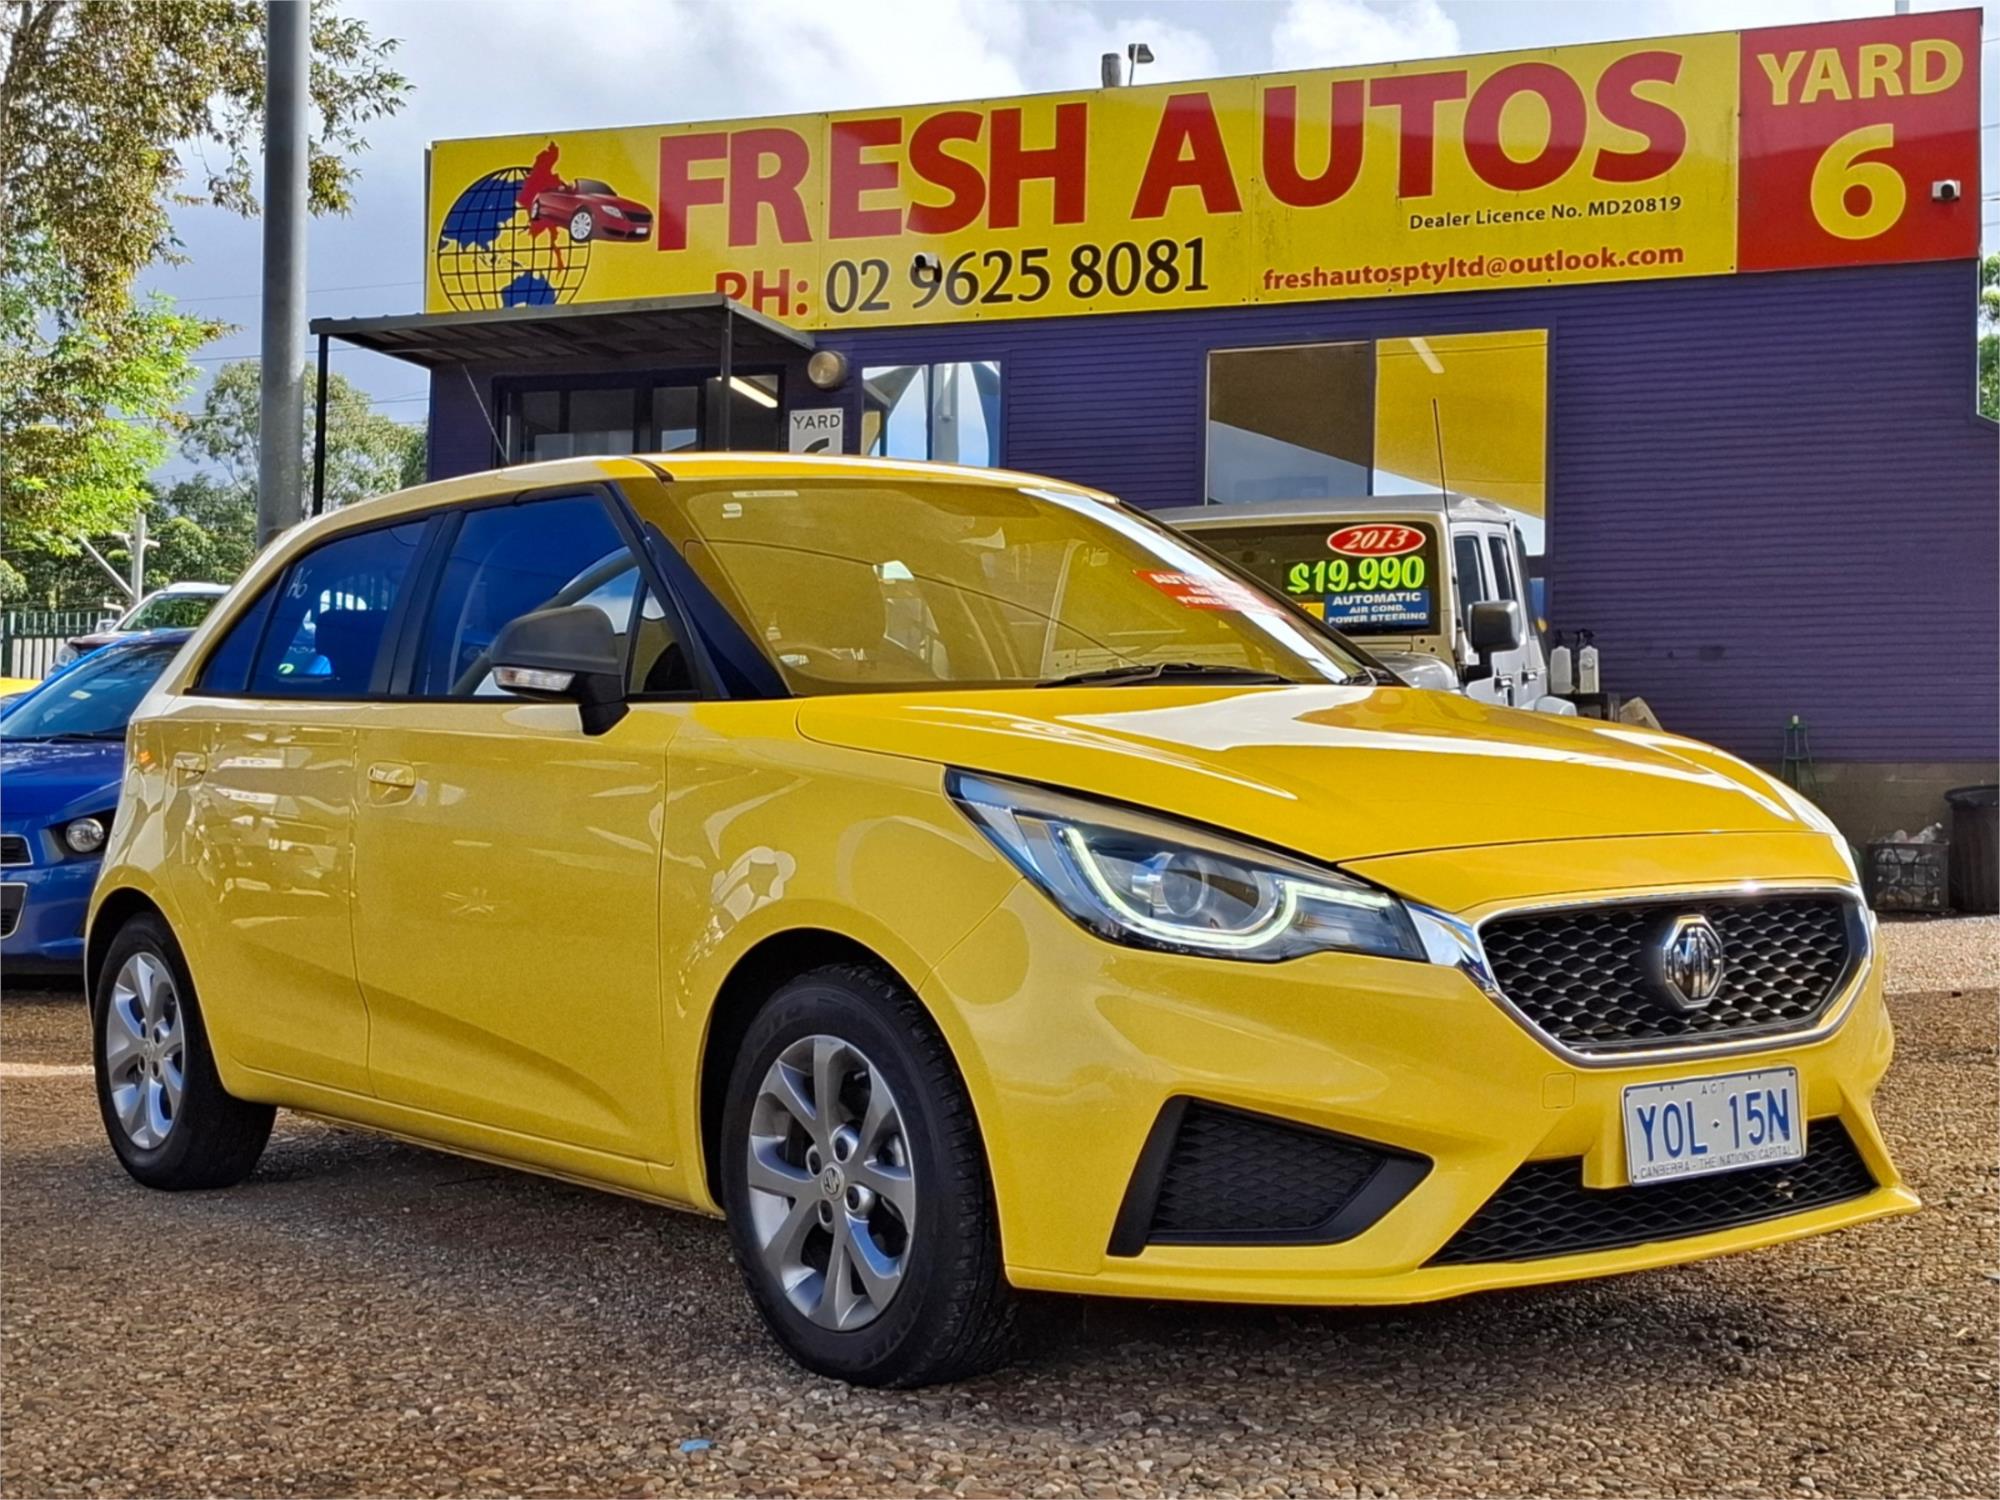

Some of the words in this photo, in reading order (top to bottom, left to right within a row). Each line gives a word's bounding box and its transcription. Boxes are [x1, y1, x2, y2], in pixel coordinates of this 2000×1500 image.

[1757, 39, 1964, 106] YARD
[656, 102, 1087, 251] FRESH
[1132, 50, 1688, 219] AUTOS
[1811, 123, 1907, 241] 6
[1409, 212, 1471, 230] Dealer
[1475, 206, 1546, 227] Licence
[1551, 203, 1583, 220] No.
[1588, 196, 1682, 217] MD20819
[715, 269, 808, 316] PH:
[826, 258, 891, 313] 02
[909, 248, 1050, 308] 9625
[1068, 237, 1209, 299] 8081
[1262, 246, 1685, 290] freshautosptyltd@outlook.com
[793, 414, 840, 430] YARD
[1343, 529, 1410, 549] 2013
[1332, 592, 1422, 606] AUTOMATIC
[1350, 605, 1369, 615] AIR
[1371, 604, 1406, 613] COND.
[1328, 615, 1368, 625] POWER
[1370, 612, 1427, 622] STEERING
[1636, 1100, 1708, 1162] YOL
[1728, 1088, 1790, 1149] 15N
[1640, 1159, 1690, 1179] CANBERRA
[1699, 1156, 1718, 1169] THE
[1758, 1145, 1793, 1160] CAPITAL
